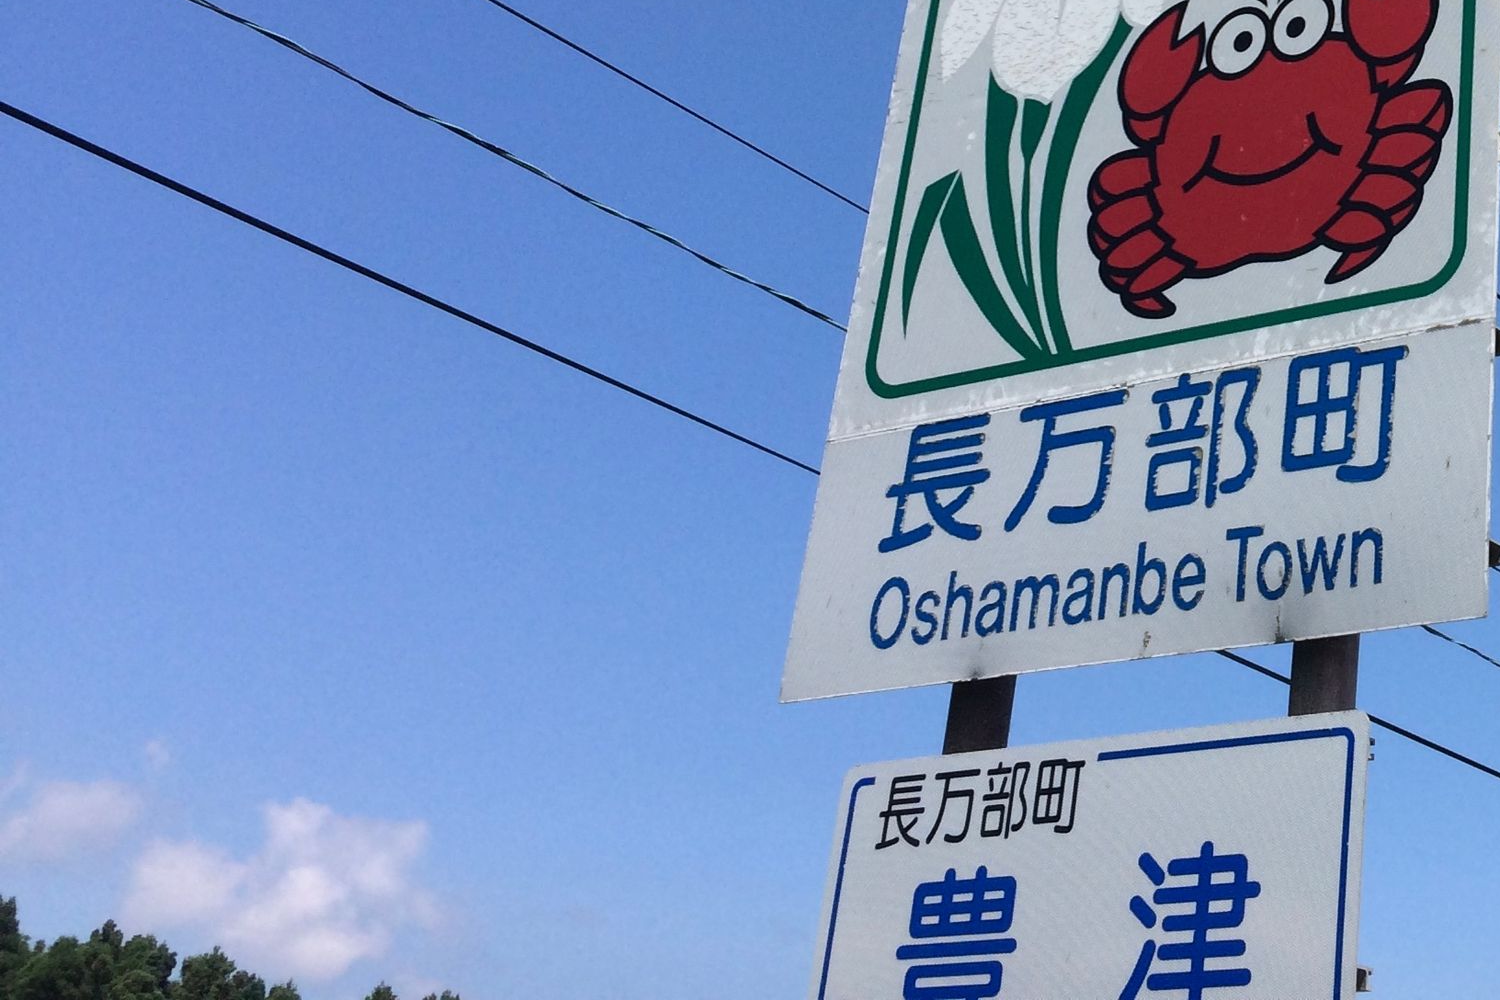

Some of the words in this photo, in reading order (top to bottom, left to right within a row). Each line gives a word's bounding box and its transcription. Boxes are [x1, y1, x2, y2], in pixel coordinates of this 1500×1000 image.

[877, 345, 1410, 553] 長万部町
[869, 541, 1207, 649] Oshamanbe
[1225, 525, 1384, 602] Town
[875, 758, 1086, 850] 長万部町
